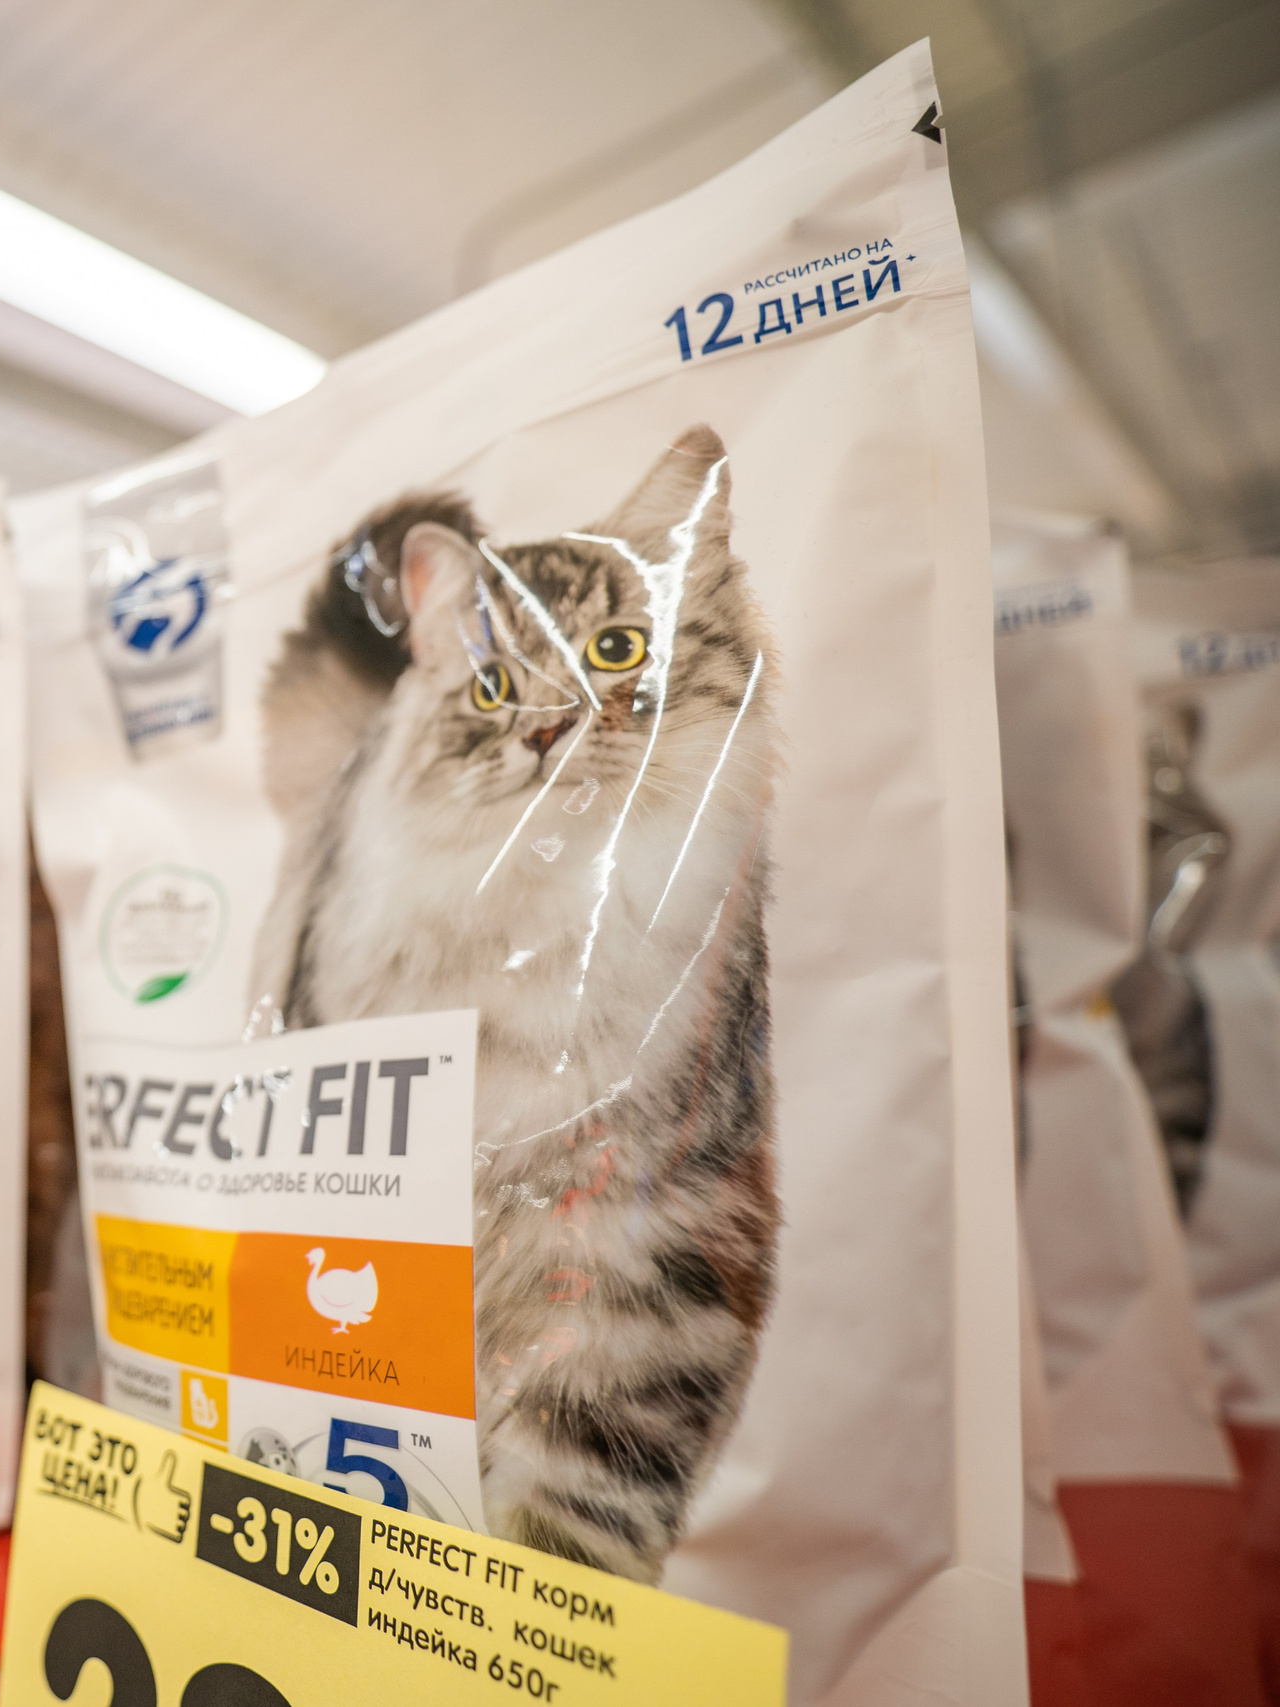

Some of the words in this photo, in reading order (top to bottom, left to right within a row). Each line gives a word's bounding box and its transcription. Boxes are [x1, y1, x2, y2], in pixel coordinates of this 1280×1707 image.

[664, 292, 743, 361] 12
[754, 255, 901, 343] ДНЕЙ
[744, 248, 861, 294] РАССЧИТАНО
[866, 238, 893, 256] НА
[300, 1057, 429, 1156] FIT
[219, 1172, 307, 1195] ЗДОРОВЬЕ
[314, 1173, 401, 1197] КОШКИ
[285, 1345, 400, 1386] ИНДЕЙКА
[35, 1408, 83, 1450] ВОТ
[88, 1430, 138, 1475] ЭТО
[42, 1453, 119, 1508] ЦЕНА!
[323, 1417, 408, 1512] 5
[210, 1496, 339, 1595] -31%
[371, 1519, 477, 1577] PERFECT
[485, 1557, 524, 1593] FIT
[533, 1579, 616, 1627] корм
[368, 1607, 478, 1672] индейка
[488, 1654, 560, 1703] 650г
[369, 1566, 493, 1632] д/чувств.
[513, 1620, 617, 1679] кошек
